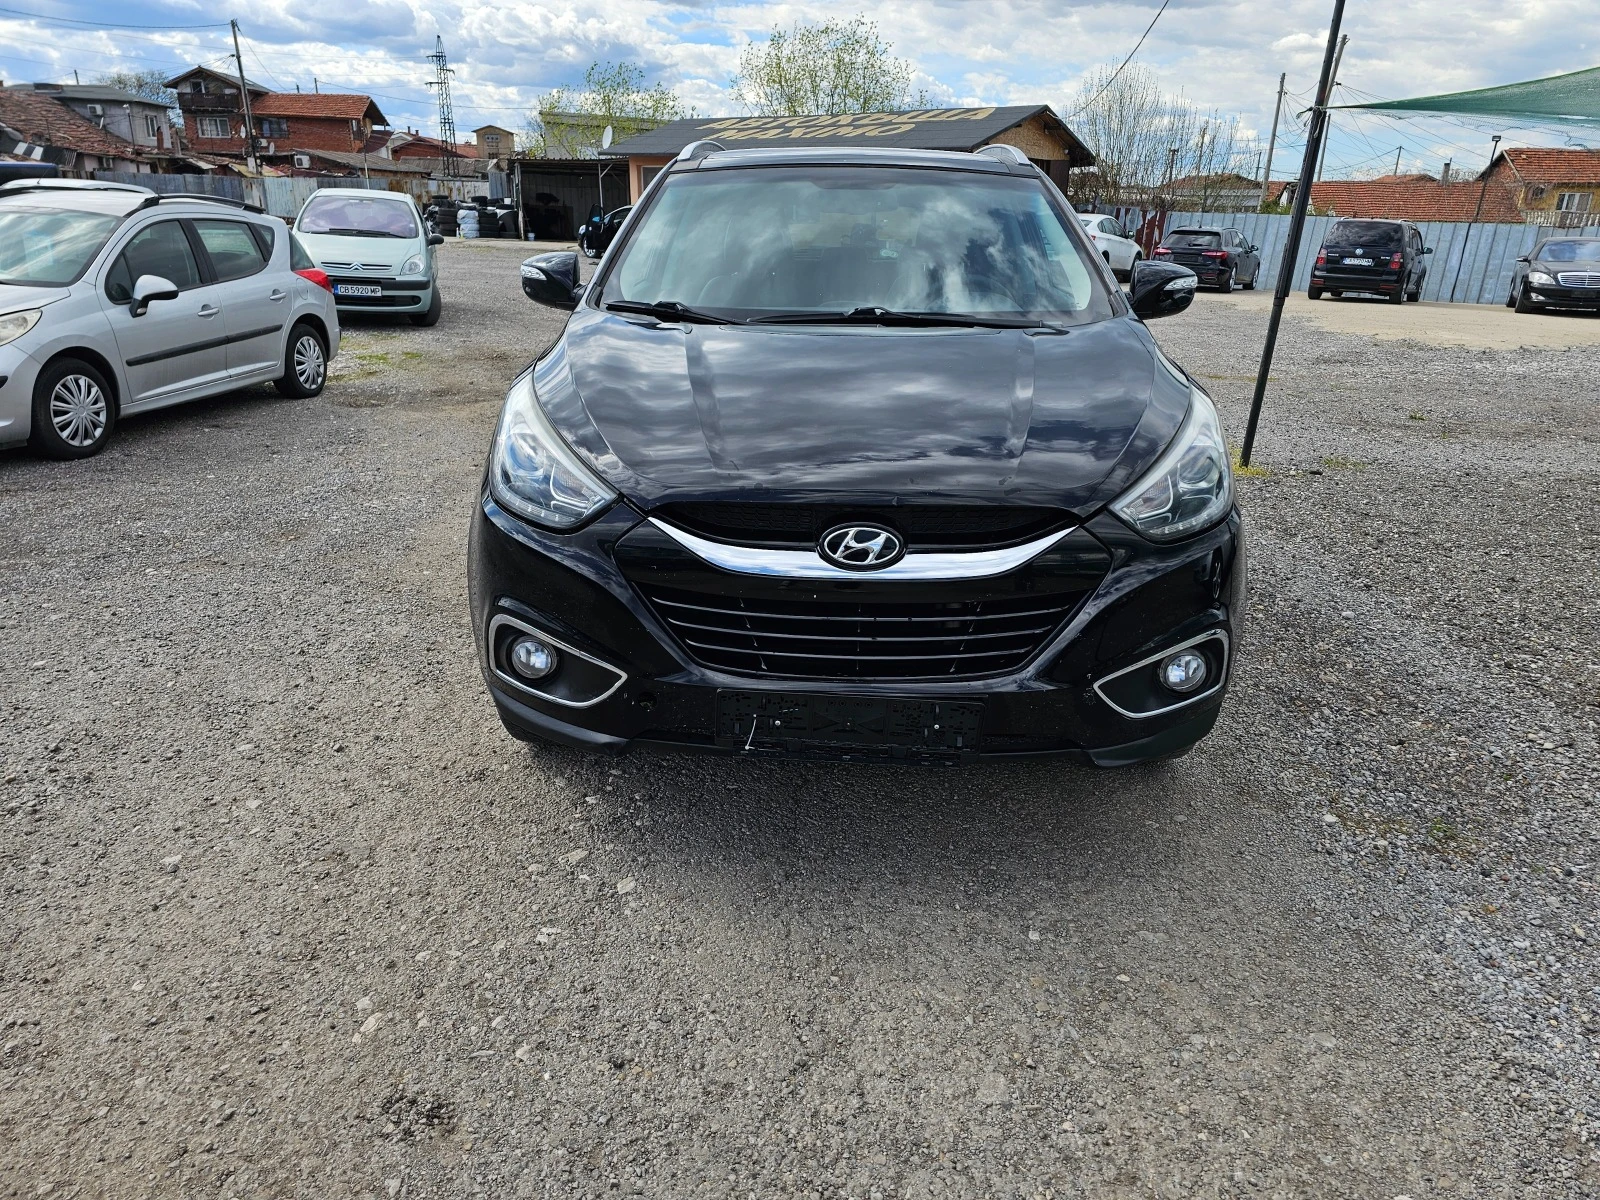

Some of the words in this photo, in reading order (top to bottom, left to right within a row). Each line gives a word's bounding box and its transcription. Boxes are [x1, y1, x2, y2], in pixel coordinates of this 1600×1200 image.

[700, 123, 916, 140] MAXIMO
[339, 285, 349, 294] CB
[350, 286, 369, 295] 5920
